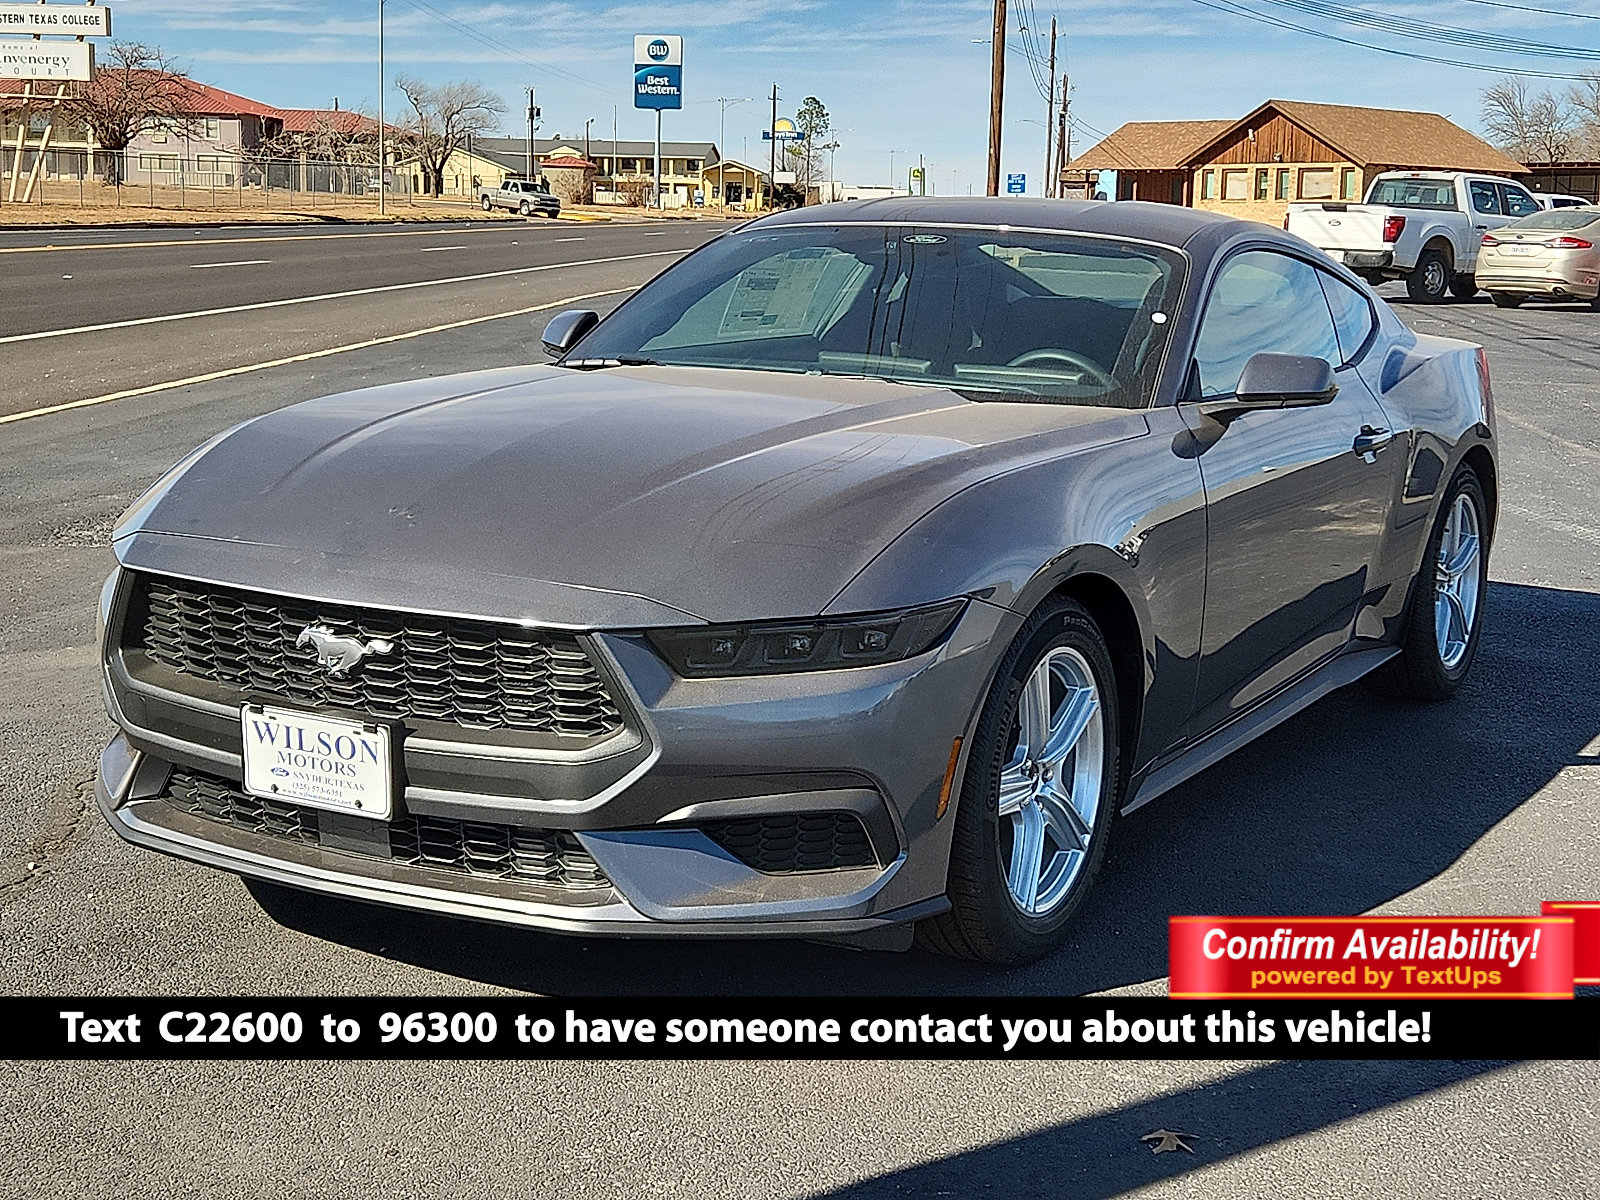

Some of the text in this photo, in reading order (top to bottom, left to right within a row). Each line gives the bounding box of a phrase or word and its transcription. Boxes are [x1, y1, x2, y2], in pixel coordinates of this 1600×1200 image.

[29, 14, 58, 25] TEXAS
[62, 15, 100, 25] COLLEGE
[649, 44, 668, 56] BW
[0, 55, 70, 68] nvenergy
[647, 75, 669, 86] Best
[252, 720, 379, 766] WILSON
[277, 751, 357, 778] MOTORS
[292, 782, 343, 797] (325) 573-6351
